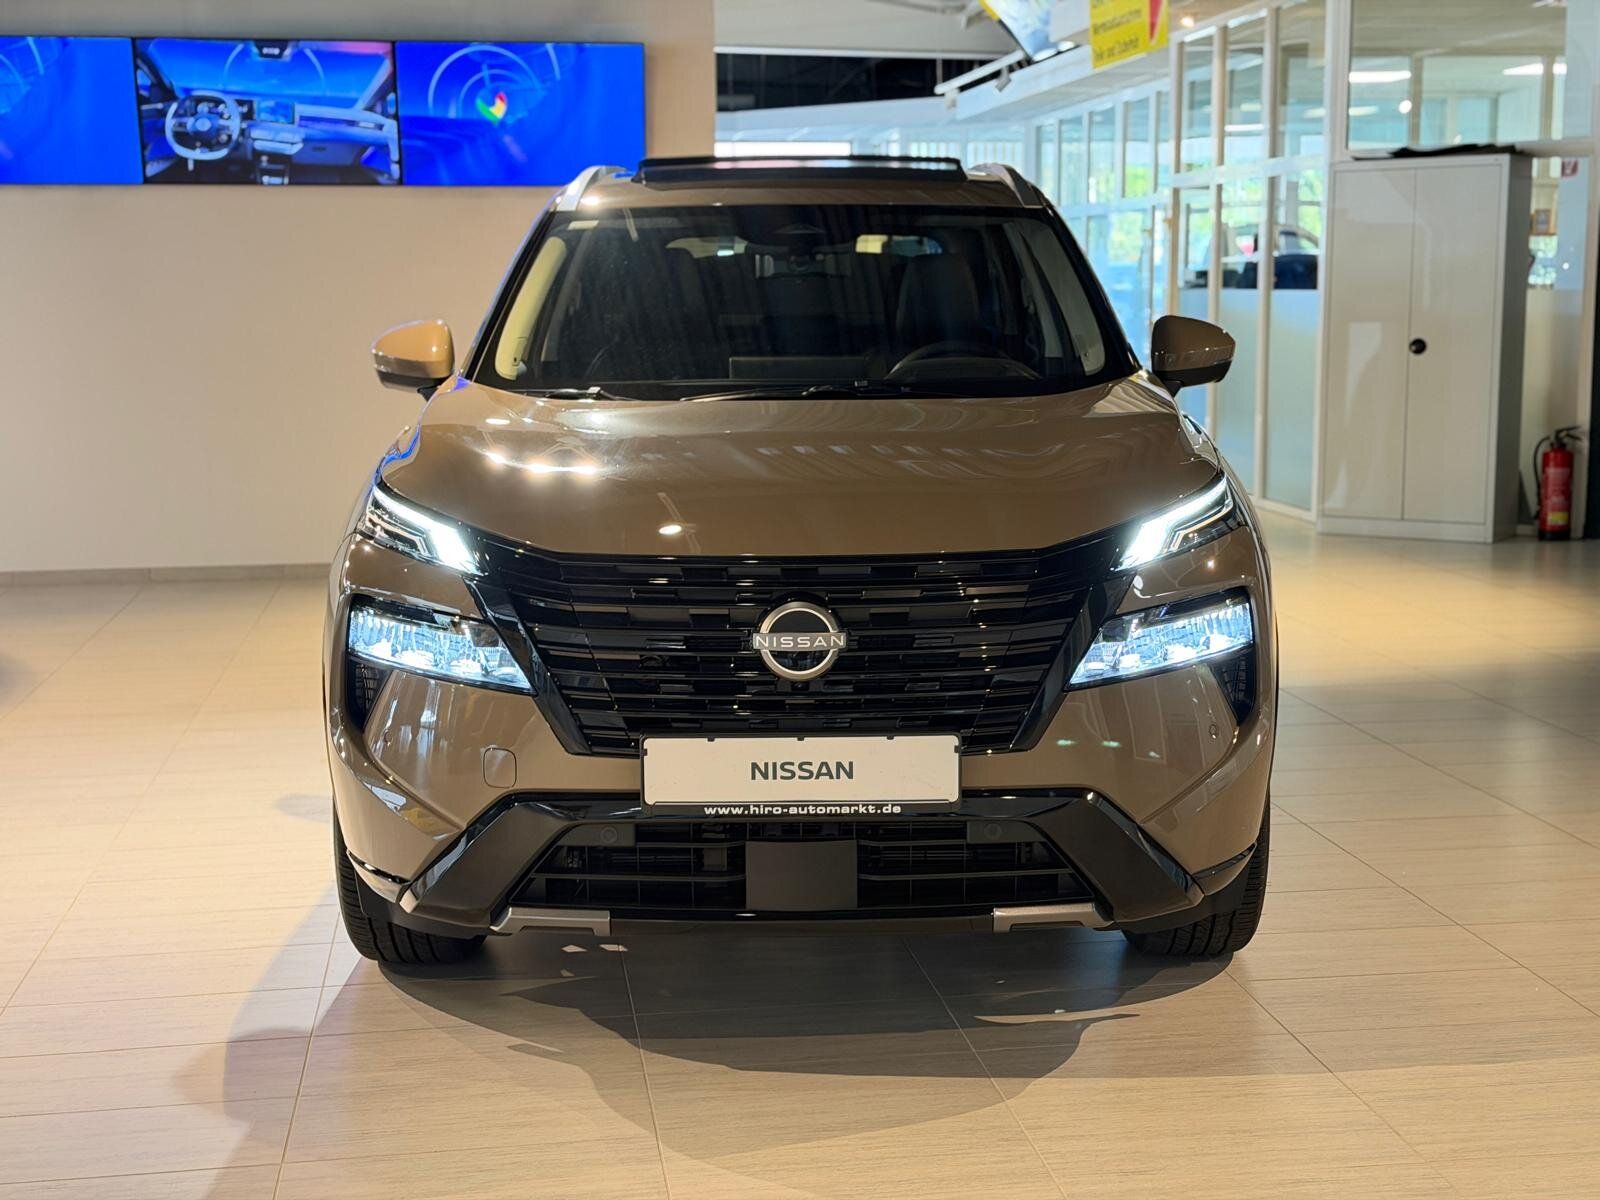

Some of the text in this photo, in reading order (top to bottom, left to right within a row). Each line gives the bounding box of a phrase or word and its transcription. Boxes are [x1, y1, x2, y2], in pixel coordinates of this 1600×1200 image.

[755, 635, 844, 648] NISSAN
[750, 761, 854, 780] NISSAN
[704, 804, 902, 815] www.hiro-automarkt.de
